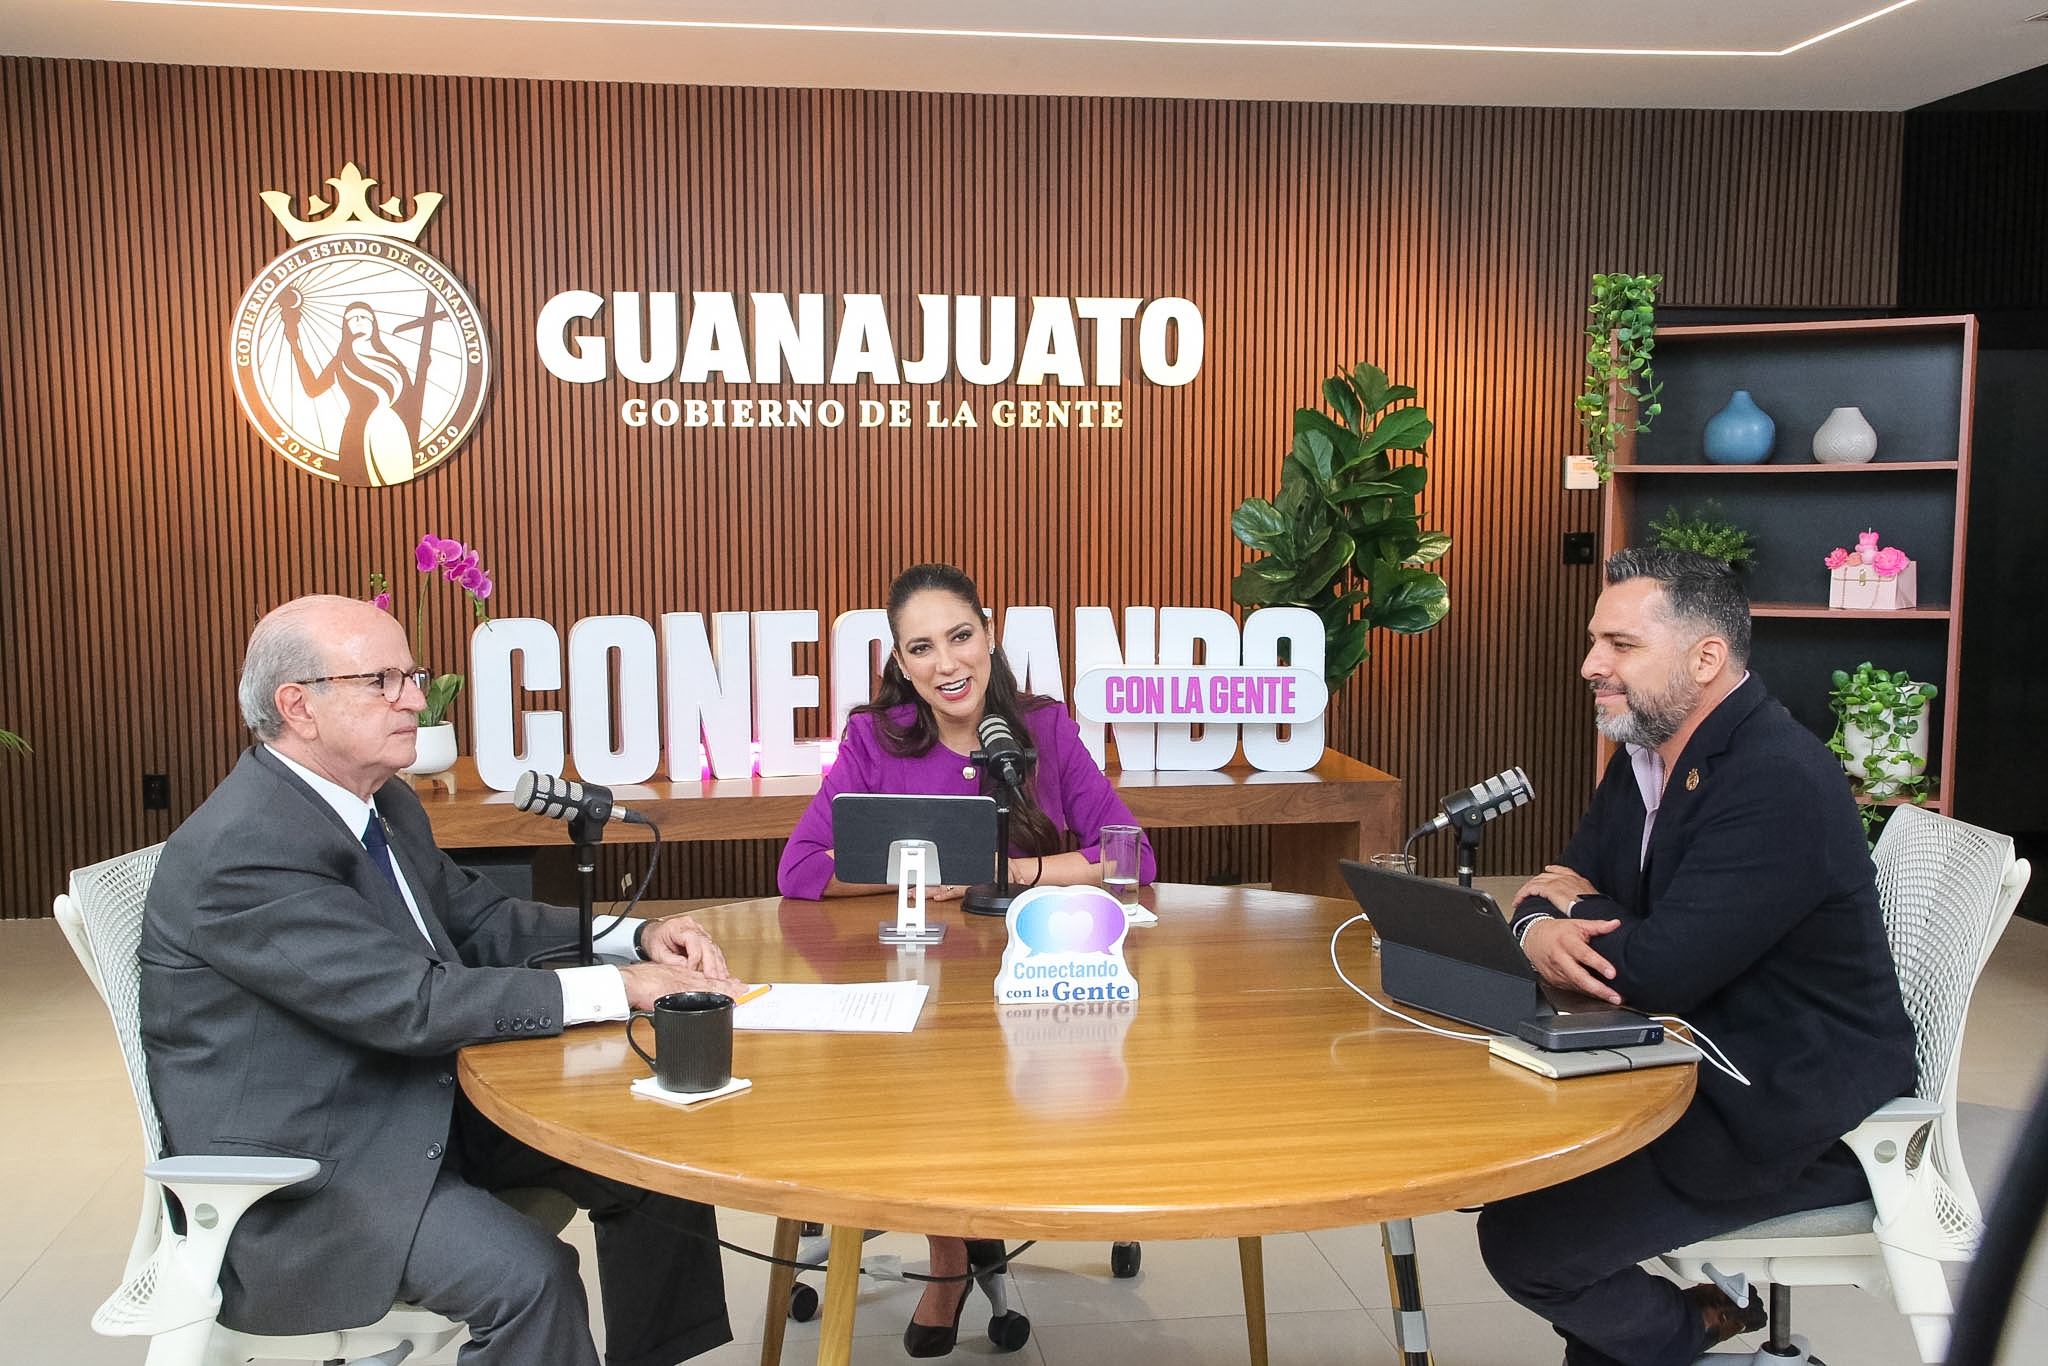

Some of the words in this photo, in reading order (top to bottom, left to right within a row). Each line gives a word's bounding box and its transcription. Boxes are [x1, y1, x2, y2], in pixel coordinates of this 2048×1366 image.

[237, 278, 276, 367] GOBIERNO
[272, 254, 307, 281] DEL
[308, 241, 382, 261] ESTADO
[386, 247, 411, 265] DE
[413, 260, 482, 364] GUANAJUATO
[535, 290, 1205, 387] GUANAJUATO
[621, 398, 845, 428] GOBIERNO
[858, 399, 912, 428] DE
[926, 400, 978, 429] LA
[991, 400, 1124, 429] GENTE
[275, 431, 323, 469] 2024
[415, 425, 459, 464] 2030
[471, 606, 1326, 792] CONEANDO
[1105, 676, 1164, 714] CON
[1171, 676, 1204, 714] LA
[1210, 676, 1296, 714] GENTE
[1013, 960, 1118, 979] Conectando
[1006, 988, 1032, 999] con
[1036, 986, 1049, 998] la
[1052, 981, 1130, 1001] Gente
